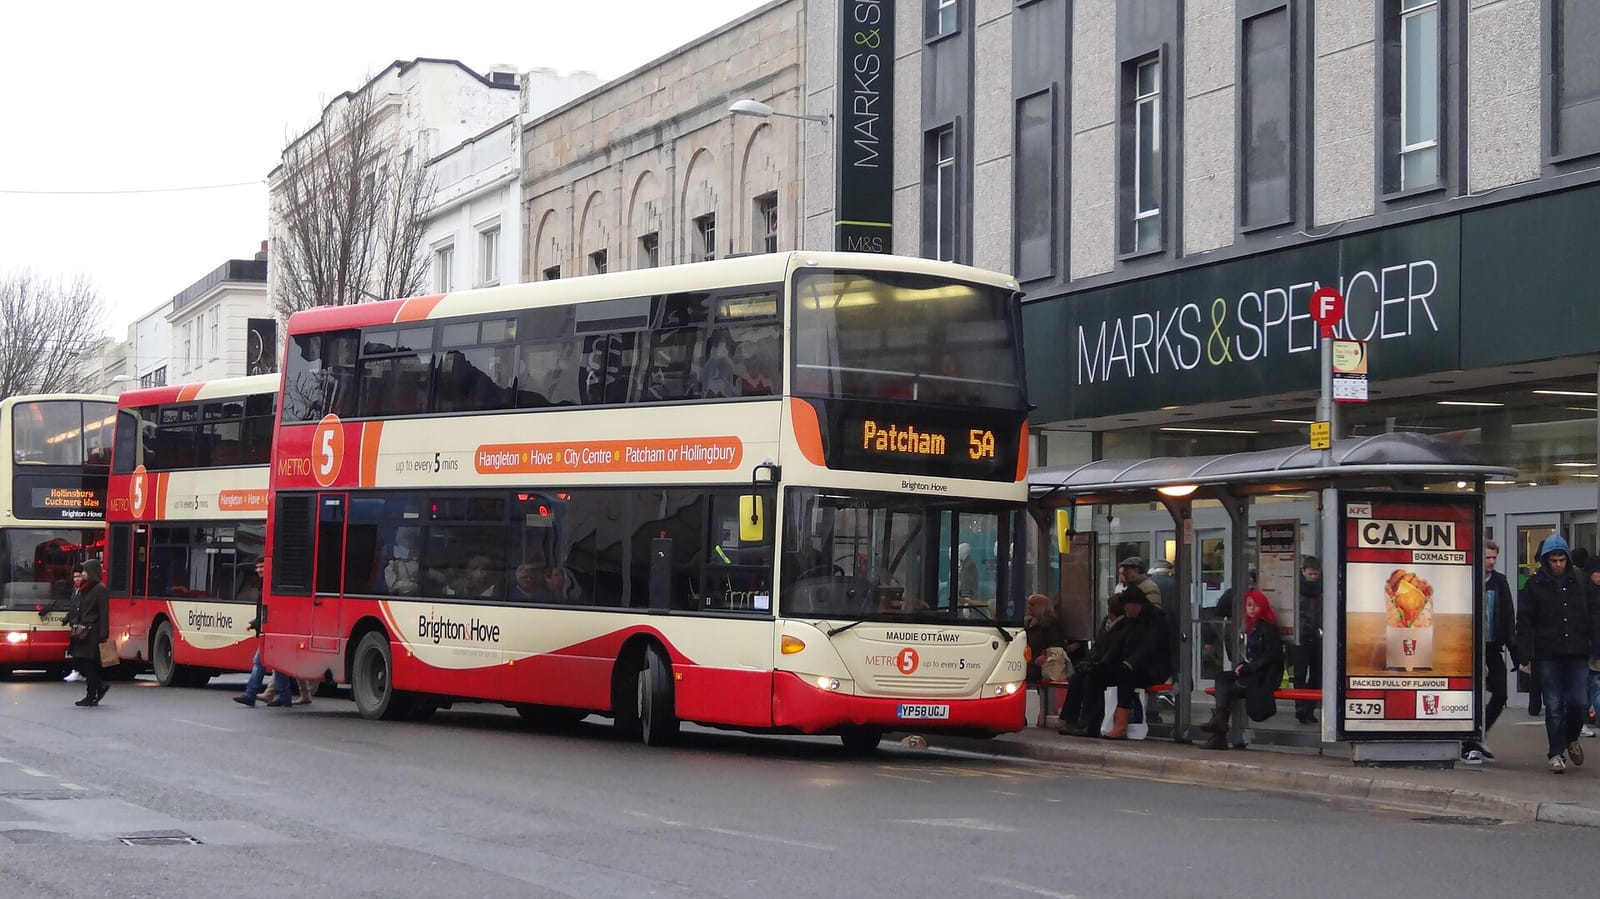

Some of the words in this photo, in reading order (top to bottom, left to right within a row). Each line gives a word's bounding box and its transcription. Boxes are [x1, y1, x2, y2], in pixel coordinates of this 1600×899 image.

[854, 0, 881, 25] S
[853, 53, 881, 168] MARKS
[848, 236, 883, 251] M&S
[1319, 296, 1336, 319] F
[1077, 303, 1202, 385] MARKS
[863, 420, 946, 455] Patcham
[968, 428, 996, 460] 5A
[320, 430, 335, 476] 5
[479, 451, 520, 470] Hangleton
[530, 449, 554, 465] Hove
[563, 448, 581, 468] City
[582, 447, 612, 464] Centre
[625, 446, 665, 463] Patcham
[667, 447, 679, 461] or
[680, 443, 736, 463] Hollingbury
[277, 457, 312, 477] METRO
[395, 461, 405, 473] up
[406, 460, 413, 471] to
[414, 459, 433, 475] every
[434, 452, 441, 473] 5
[442, 458, 459, 471] mins
[134, 476, 143, 510] 5
[901, 480, 929, 491] Brighton
[931, 483, 948, 492] Hove
[1349, 507, 1369, 515] KFC
[1414, 553, 1465, 562] BOXMASTER
[188, 610, 215, 631] Brighton
[886, 631, 919, 641] MAUDIE
[920, 632, 960, 642] OTTAWAY
[902, 651, 914, 671] 5
[922, 661, 933, 670] up
[940, 661, 957, 670] every
[959, 658, 966, 670] 5
[1006, 660, 1022, 672] 709
[902, 706, 926, 717] YP58
[928, 706, 947, 717] UGJ
[1349, 703, 1382, 714] £3.79
